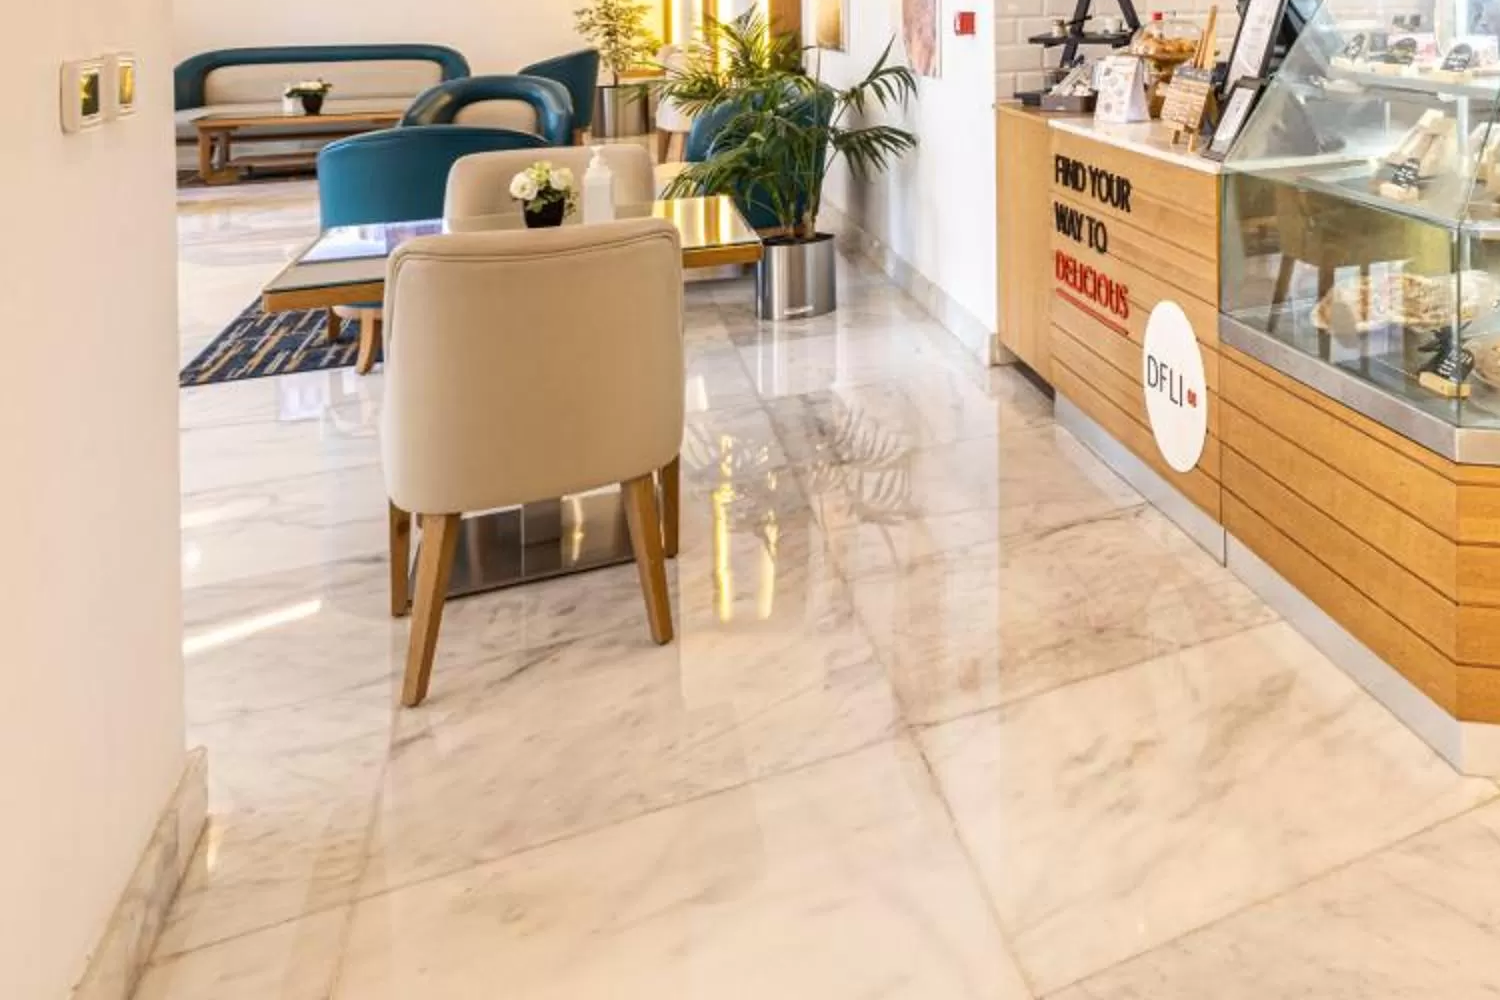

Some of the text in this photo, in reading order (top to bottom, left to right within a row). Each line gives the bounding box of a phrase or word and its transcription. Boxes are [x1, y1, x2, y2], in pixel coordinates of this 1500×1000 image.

[1055, 153, 1132, 213] FIND YOUR
[1054, 200, 1108, 254] WAY TO
[1055, 249, 1129, 319] DELICIOUS
